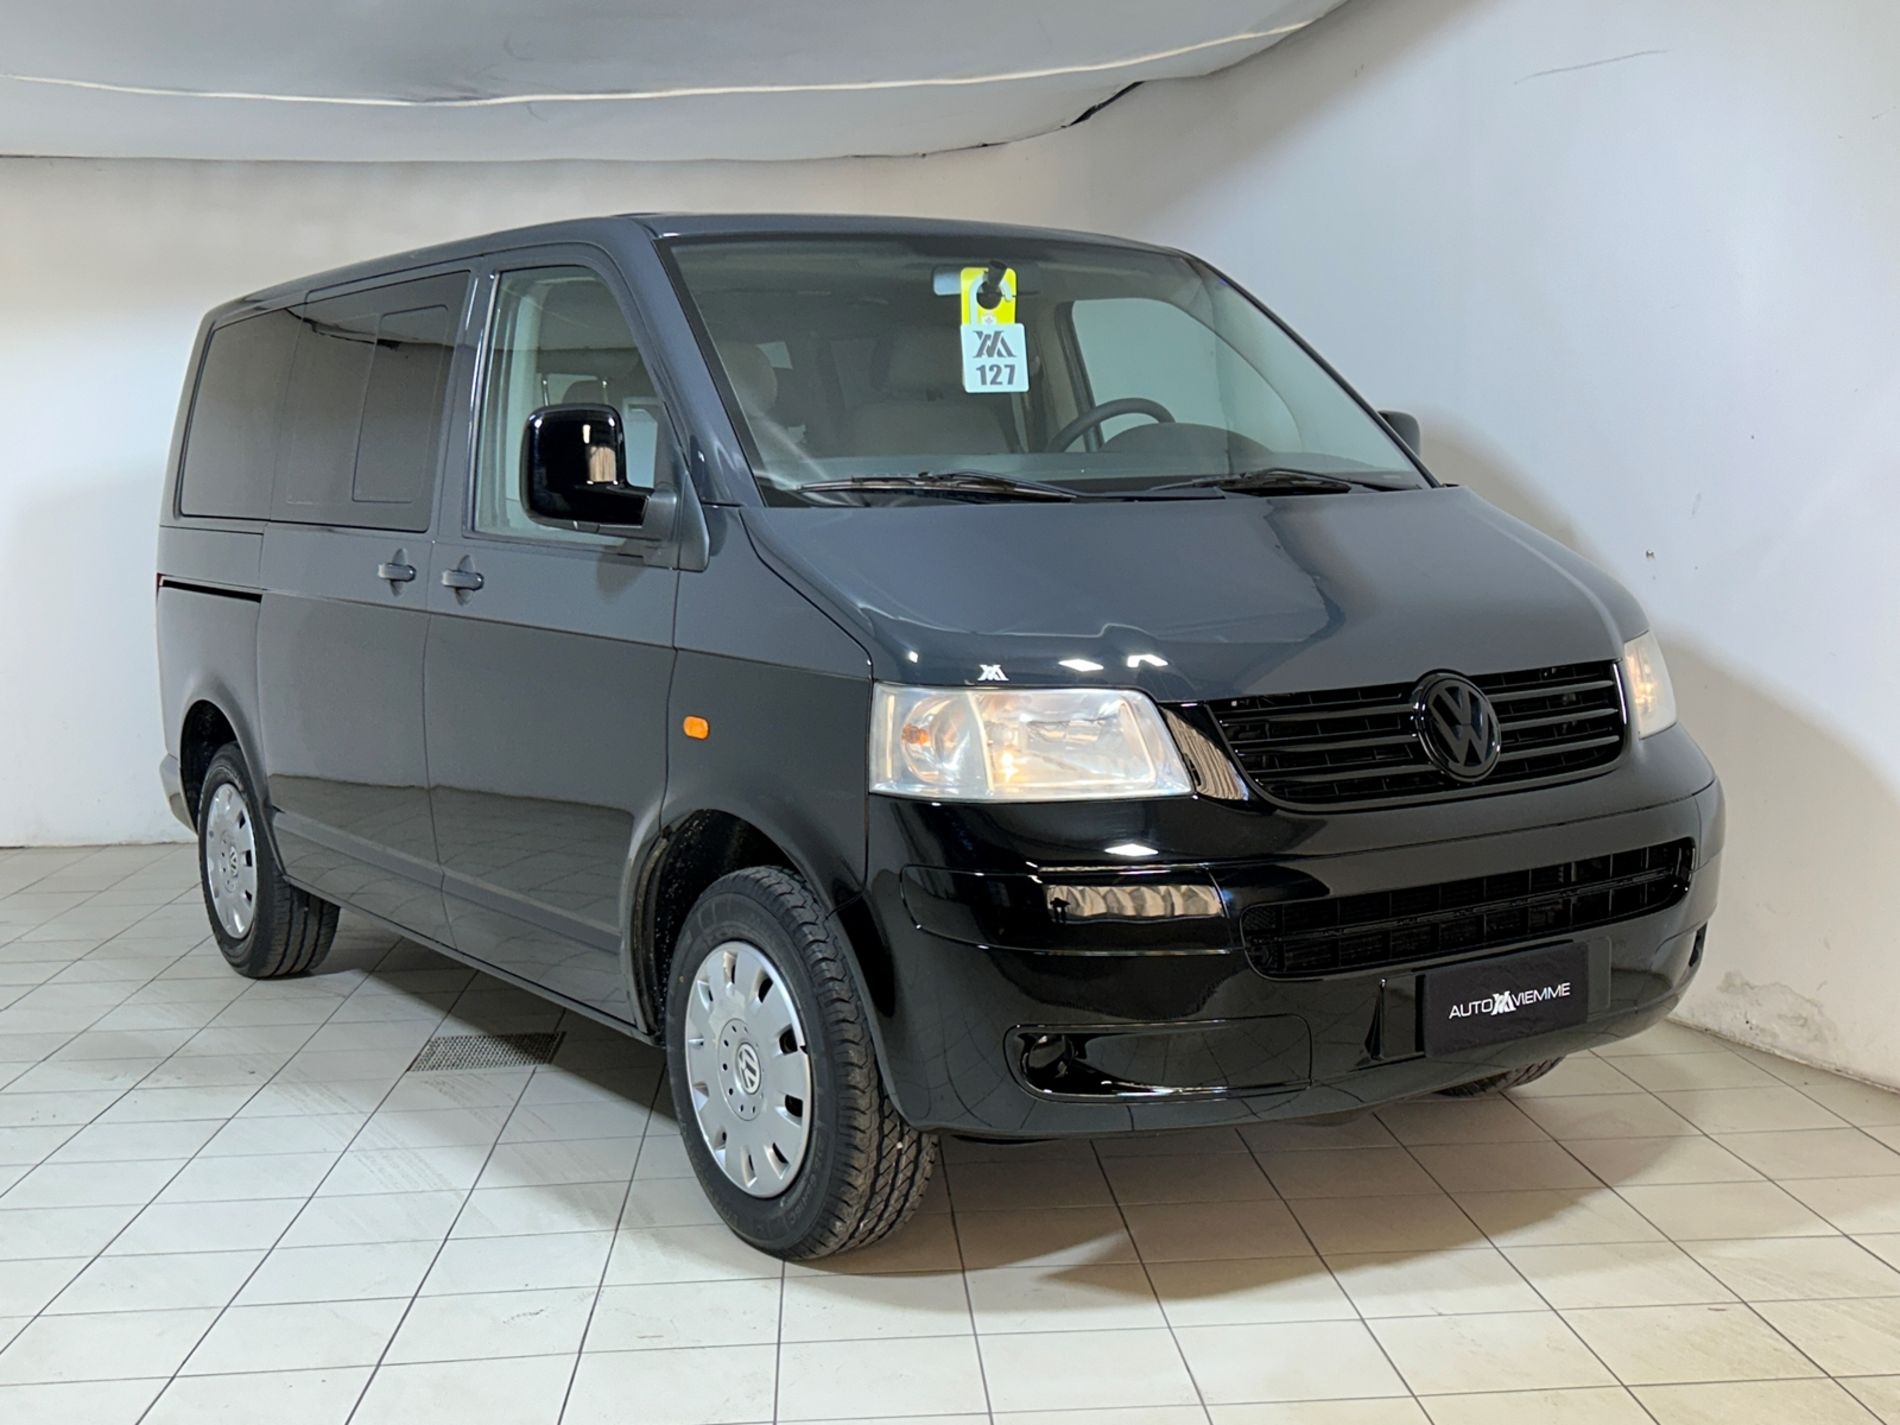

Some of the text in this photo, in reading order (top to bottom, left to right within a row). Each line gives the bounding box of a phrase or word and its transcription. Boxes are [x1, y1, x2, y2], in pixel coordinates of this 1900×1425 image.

[976, 364, 1016, 386] 127
[1448, 998, 1494, 1019] AUTO
[1511, 982, 1571, 1007] VIEMME
